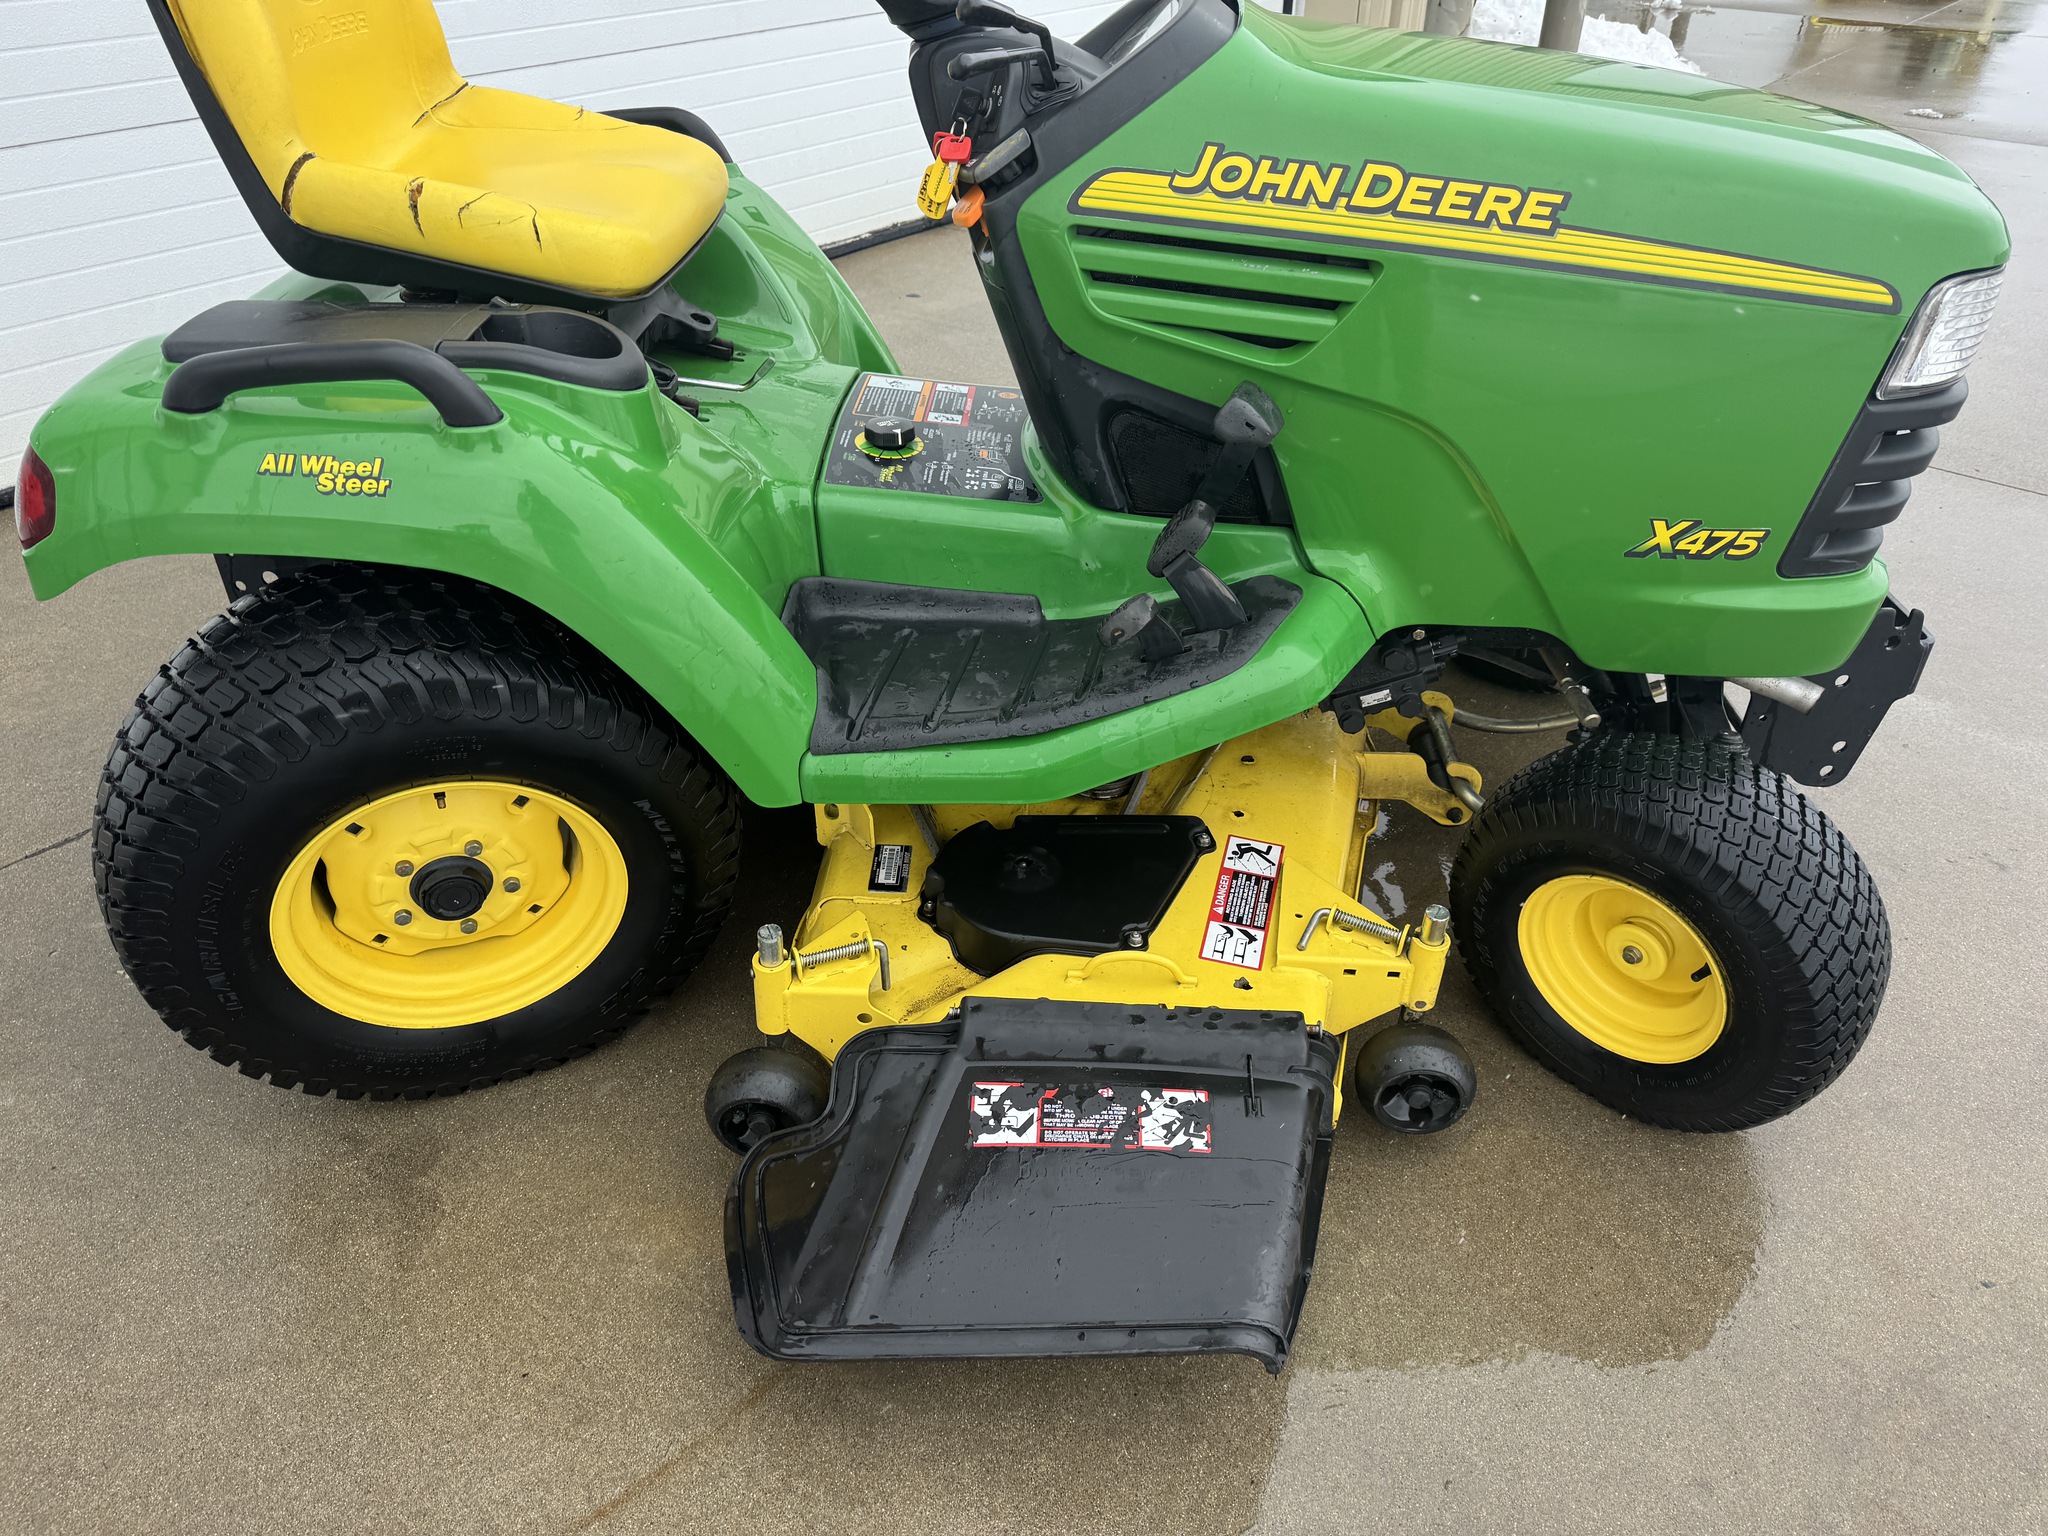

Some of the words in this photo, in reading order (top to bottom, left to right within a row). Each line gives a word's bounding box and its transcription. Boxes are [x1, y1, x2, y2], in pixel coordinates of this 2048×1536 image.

[289, 24, 317, 57] JOHN
[316, 10, 369, 44] DEERE
[1171, 143, 1345, 206] JOHN
[1348, 161, 1567, 231] DEERE
[258, 453, 296, 475] All
[300, 454, 383, 478] Wheel
[876, 467, 888, 482] Steer
[883, 466, 896, 481] Wheel
[894, 464, 904, 472] All
[316, 472, 391, 496] Steer
[1626, 519, 1769, 558] X475
[632, 798, 687, 874] MULTI
[1216, 874, 1229, 905] DANGER
[193, 849, 247, 1011] CARLISLE
[1470, 876, 1496, 969] MULTI
